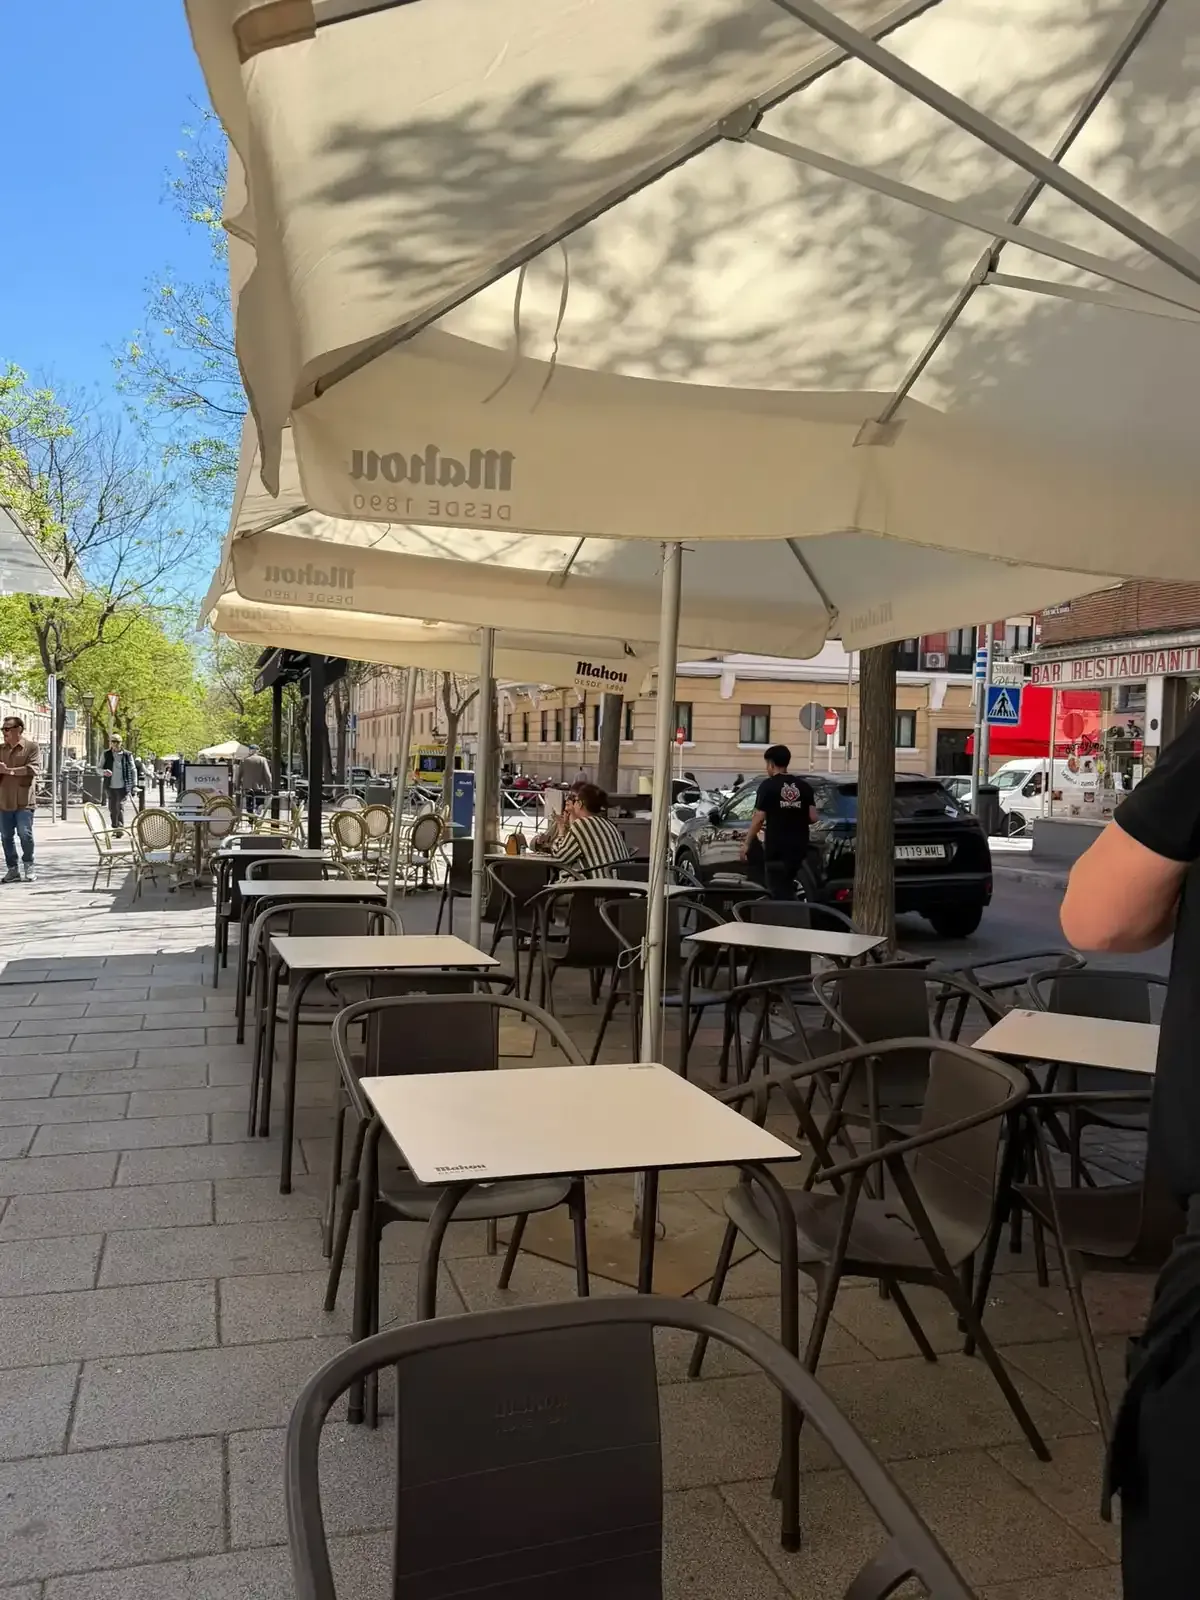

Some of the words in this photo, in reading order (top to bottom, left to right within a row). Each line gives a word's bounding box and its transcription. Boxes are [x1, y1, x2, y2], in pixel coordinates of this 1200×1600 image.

[576, 661, 628, 683] Mahou
[1032, 663, 1061, 684] BAR
[899, 846, 922, 857] 1119
